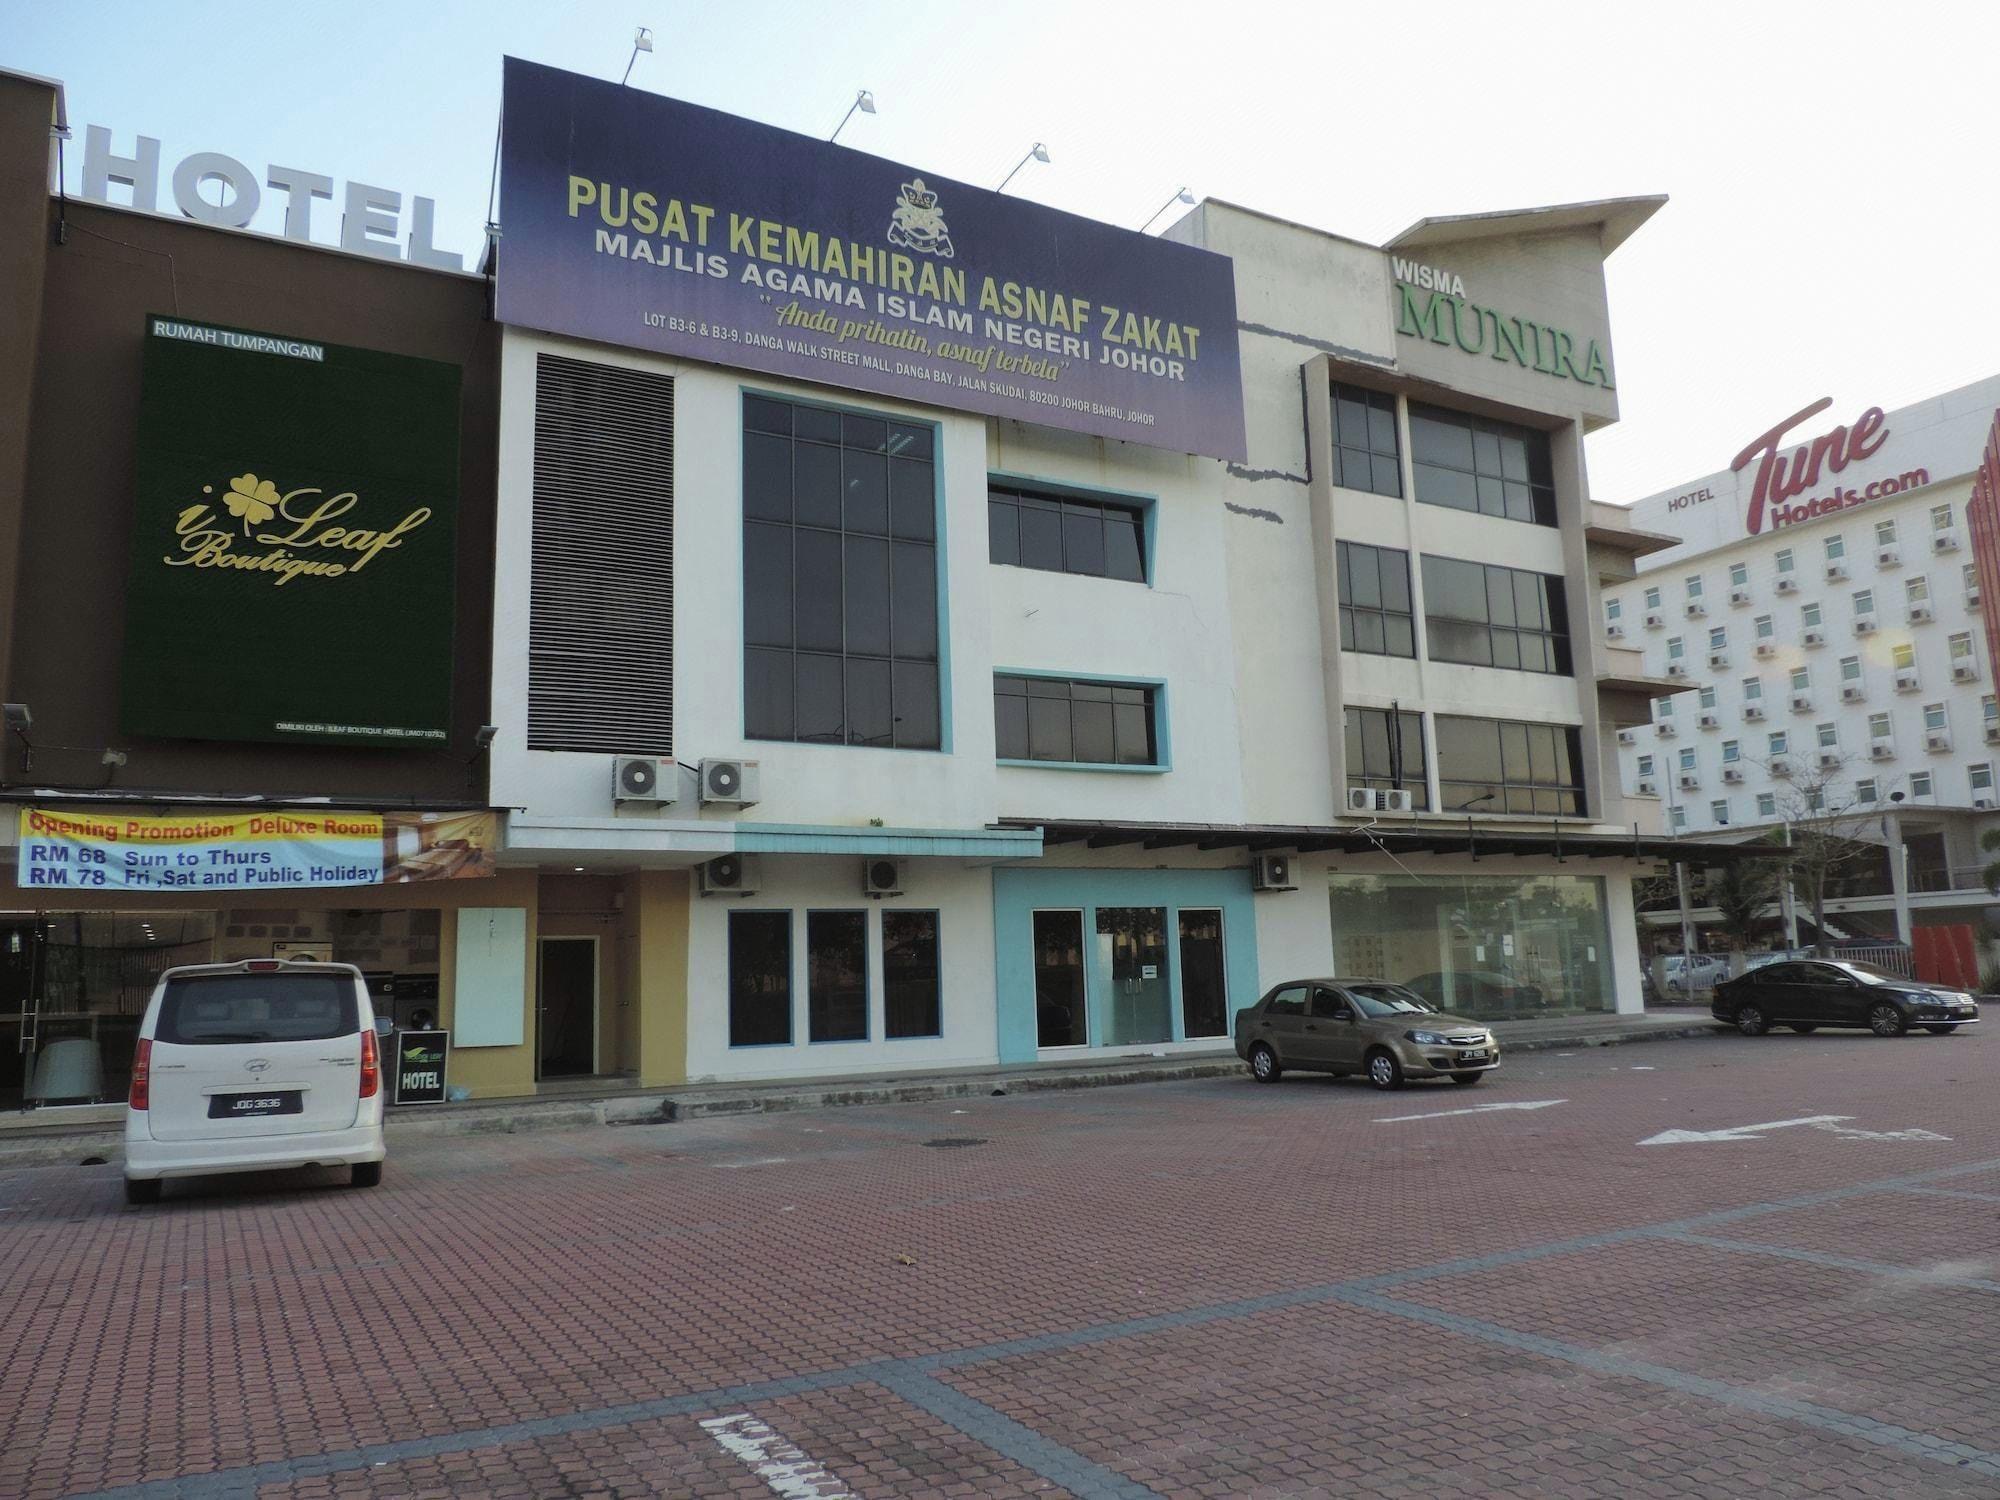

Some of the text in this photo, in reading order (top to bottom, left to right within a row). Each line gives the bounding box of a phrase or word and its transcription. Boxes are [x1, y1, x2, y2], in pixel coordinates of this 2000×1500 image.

[82, 124, 463, 271] HOTEL
[568, 175, 1200, 361] PUSAT KEMAHIRAN ASNAF ZAKAT
[1391, 256, 1467, 299] WISMA
[595, 229, 1185, 382] MAJLIS AGAMA ISLAM NEGERI JOHOR
[154, 321, 323, 360] RUMAH TUMPANGAN
[937, 341, 996, 373] asnaf
[1395, 282, 1617, 390] MUNIRA
[644, 311, 666, 328] LOT
[669, 317, 696, 334] B3-6
[699, 322, 709, 337] &
[745, 332, 784, 351] DANGA
[786, 340, 818, 358] WALK
[820, 346, 860, 366] STREET
[862, 355, 893, 374] MALL,
[896, 362, 931, 381] DANGA
[957, 375, 987, 392] JALAN
[1030, 390, 1060, 407] 80200
[1061, 396, 1090, 414] JOHOR
[1092, 403, 1126, 421] BAHRU,
[1127, 410, 1155, 427] JOHOR
[1730, 396, 1890, 535] Tune
[1667, 488, 1714, 513] HOTEL
[1771, 467, 1929, 530] Hotels.com
[256, 488, 432, 572] Leaf
[163, 530, 347, 585] Boutique
[347, 726, 383, 735] BOUTIQUE
[383, 728, 404, 736] HOTEL
[29, 812, 378, 842] Opening Promotion Deluxe Room
[30, 868, 68, 884] RM
[77, 869, 106, 885] 78
[125, 869, 149, 884] Fri
[203, 869, 237, 885] and
[245, 867, 303, 883] Public
[310, 865, 378, 883] Holiday
[31, 845, 272, 866] RM 68 Sun to Thurs
[402, 1071, 440, 1090] HOTEL
